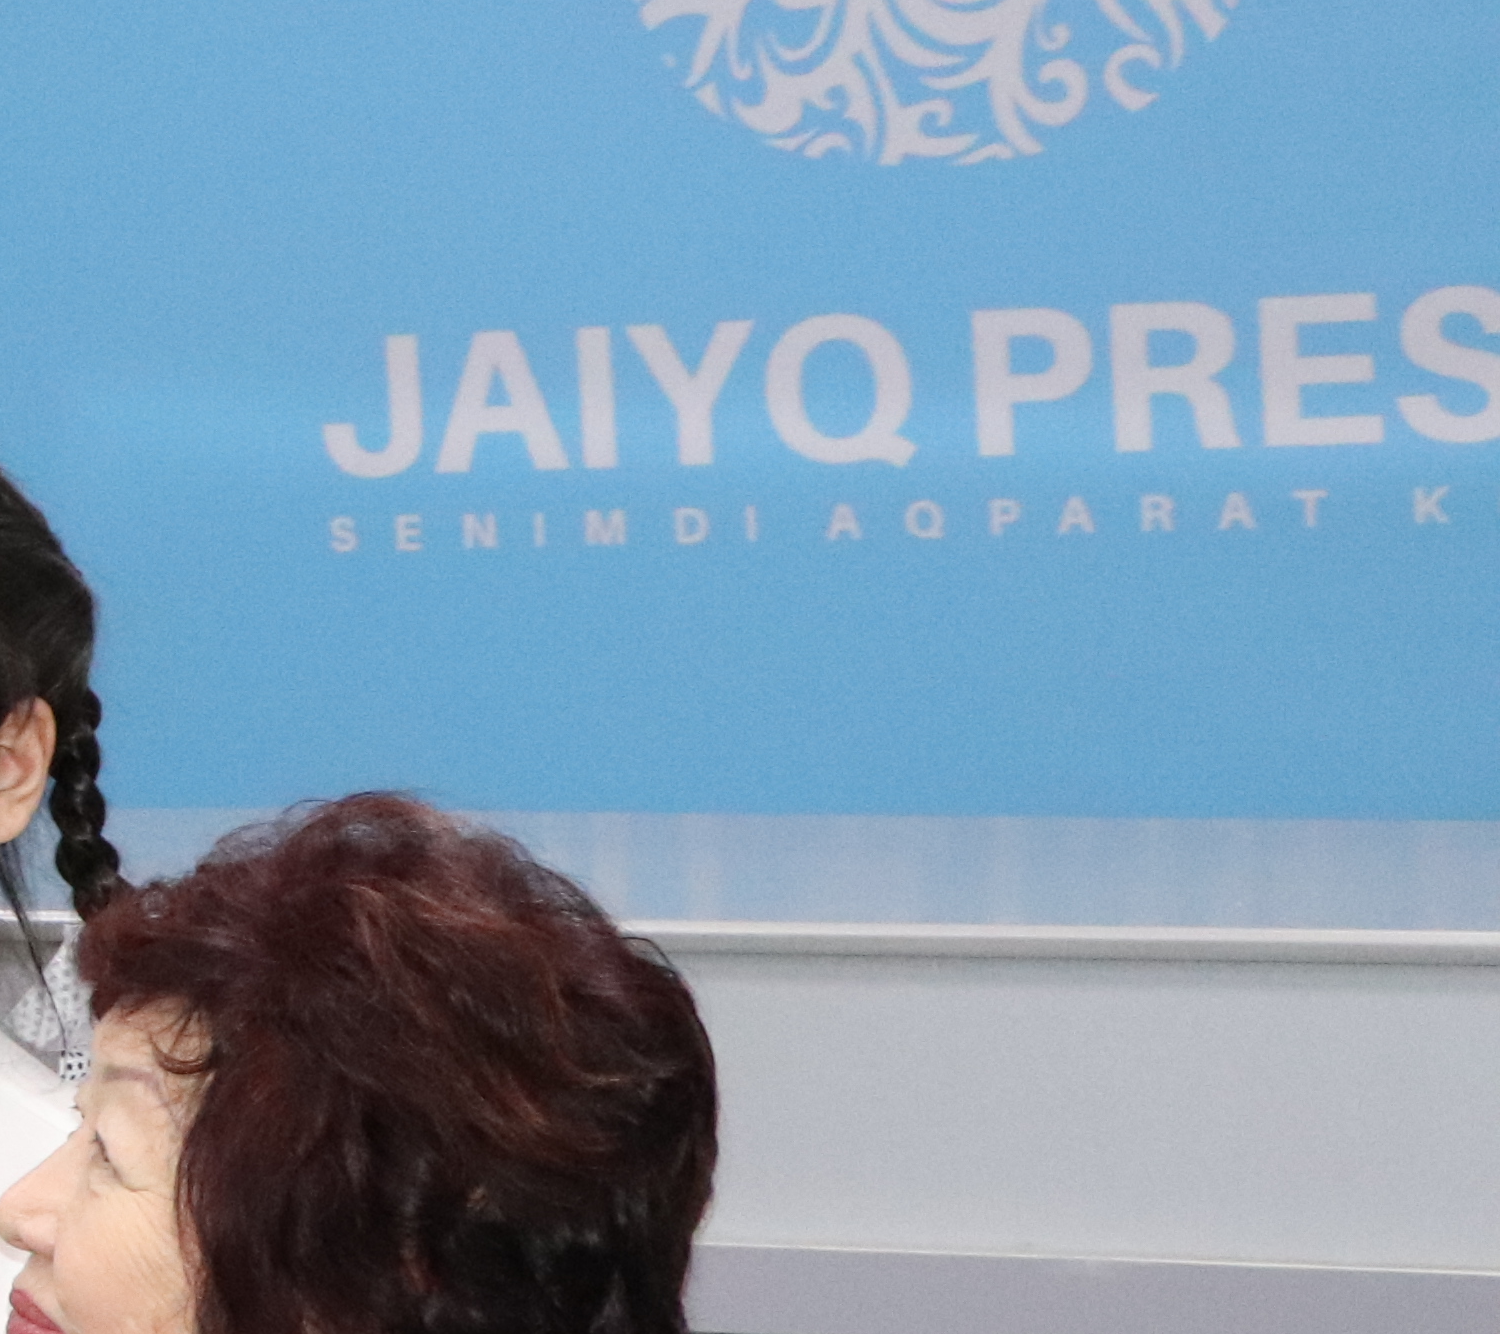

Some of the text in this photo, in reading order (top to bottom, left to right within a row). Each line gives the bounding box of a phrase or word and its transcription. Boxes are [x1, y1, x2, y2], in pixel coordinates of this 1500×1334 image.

[322, 285, 1500, 479] JAIYQ PRES
[329, 504, 758, 553] SENIMDI
[826, 488, 1328, 541] AQPARAT
